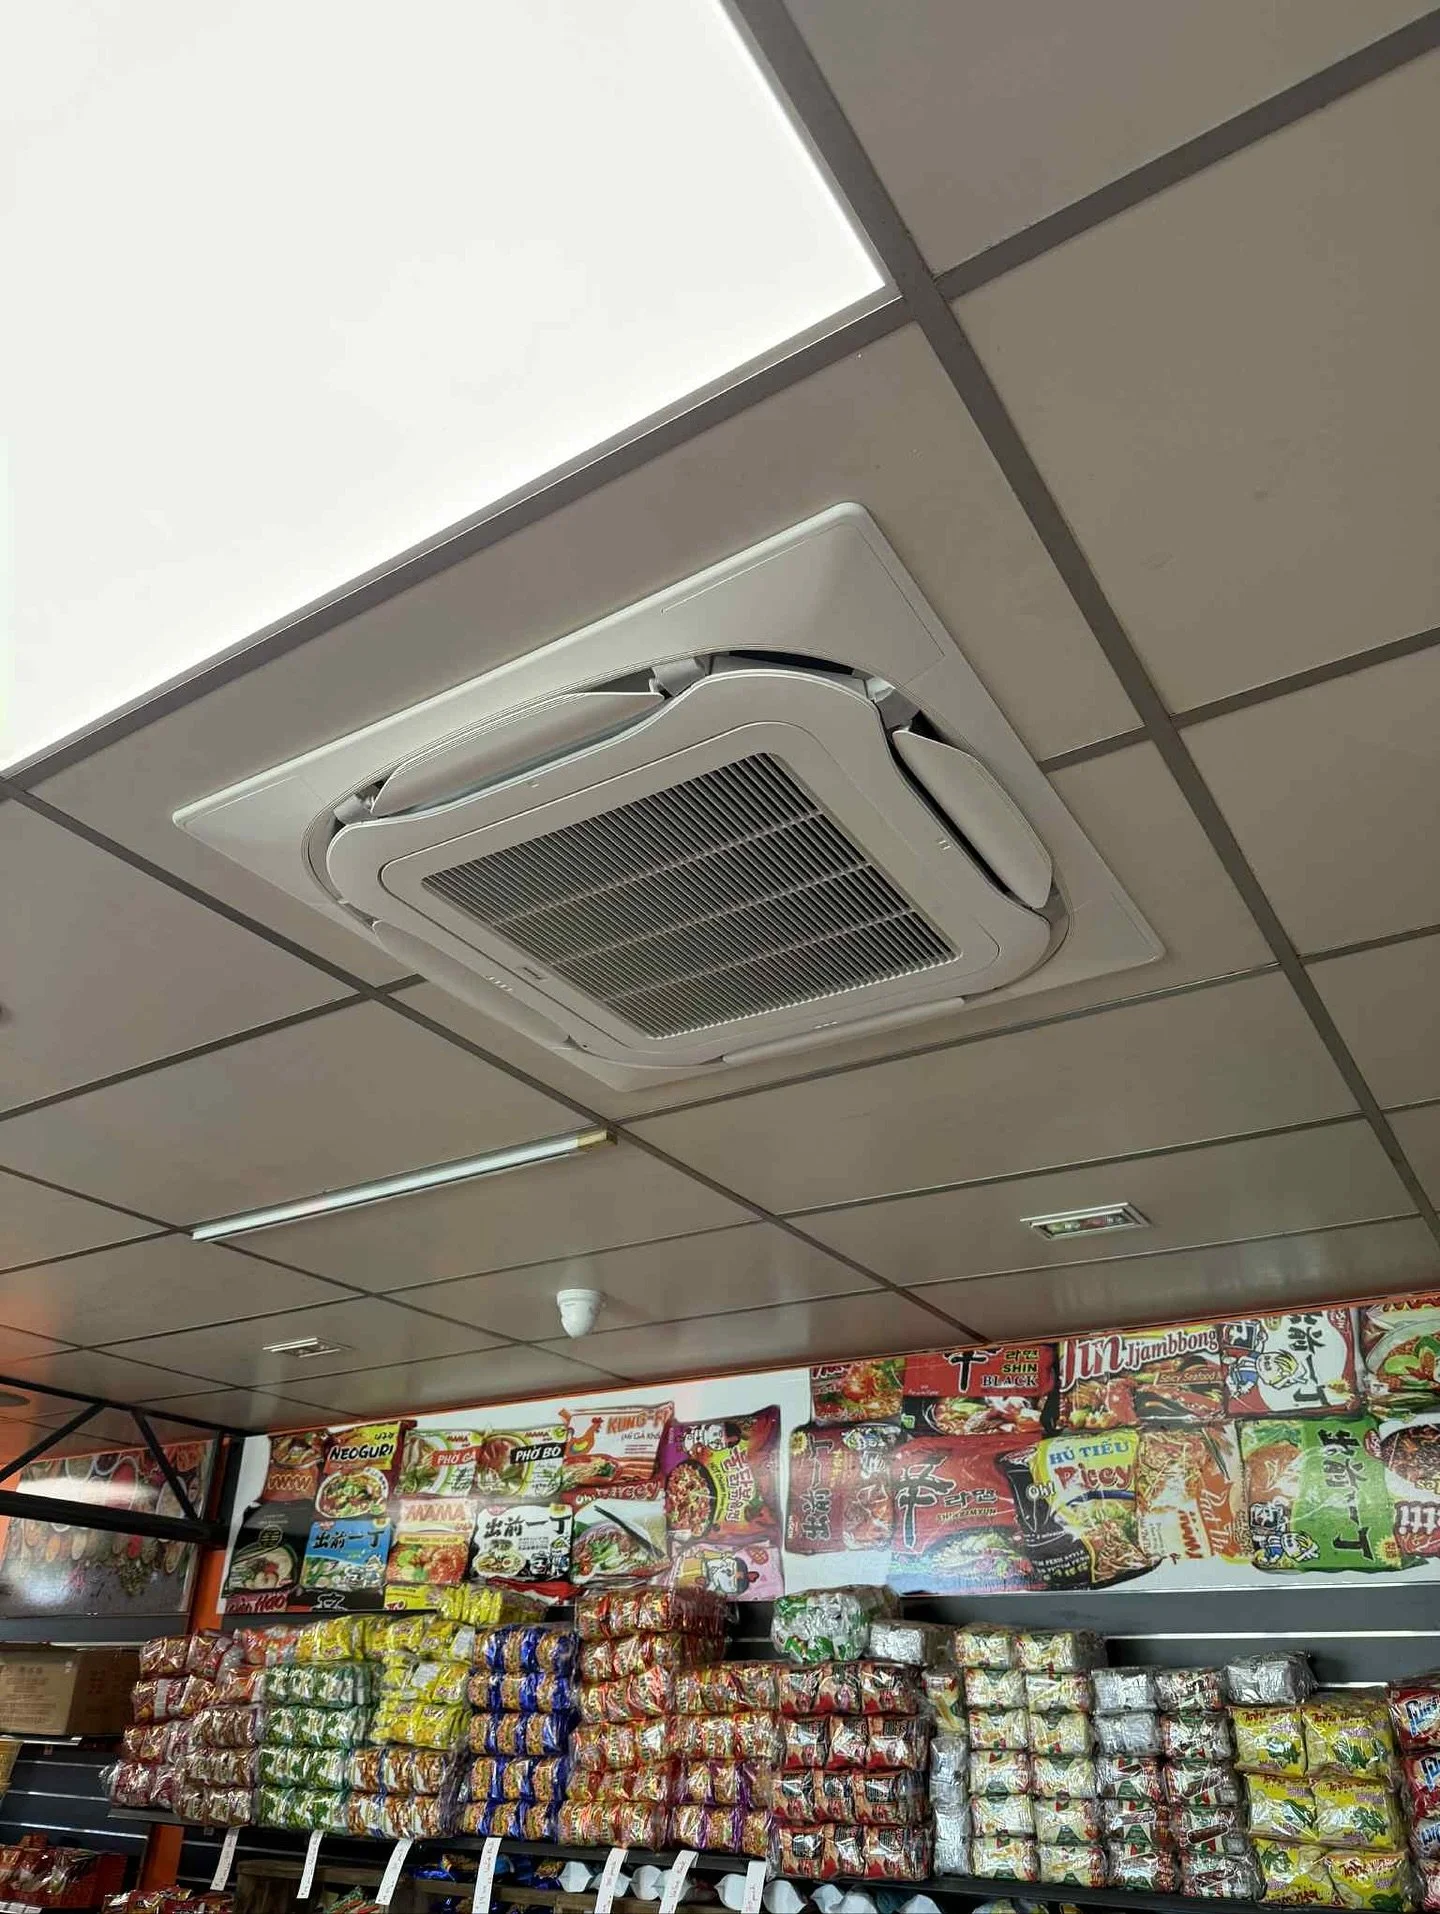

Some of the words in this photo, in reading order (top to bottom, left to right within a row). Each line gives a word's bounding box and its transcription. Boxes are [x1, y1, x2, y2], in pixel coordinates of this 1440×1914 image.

[1003, 1363, 1038, 1374] SHIN
[1060, 1334, 1122, 1392] Jin
[1125, 1329, 1219, 1371] Jjambbong
[983, 1375, 1038, 1388] BLACK
[330, 1443, 394, 1460] NEOGURI
[801, 1434, 835, 1541] 出前一丁
[1199, 1488, 1228, 1522] Pad
[484, 1514, 572, 1539] 出前一丁
[313, 1530, 385, 1549] 出前一丁
